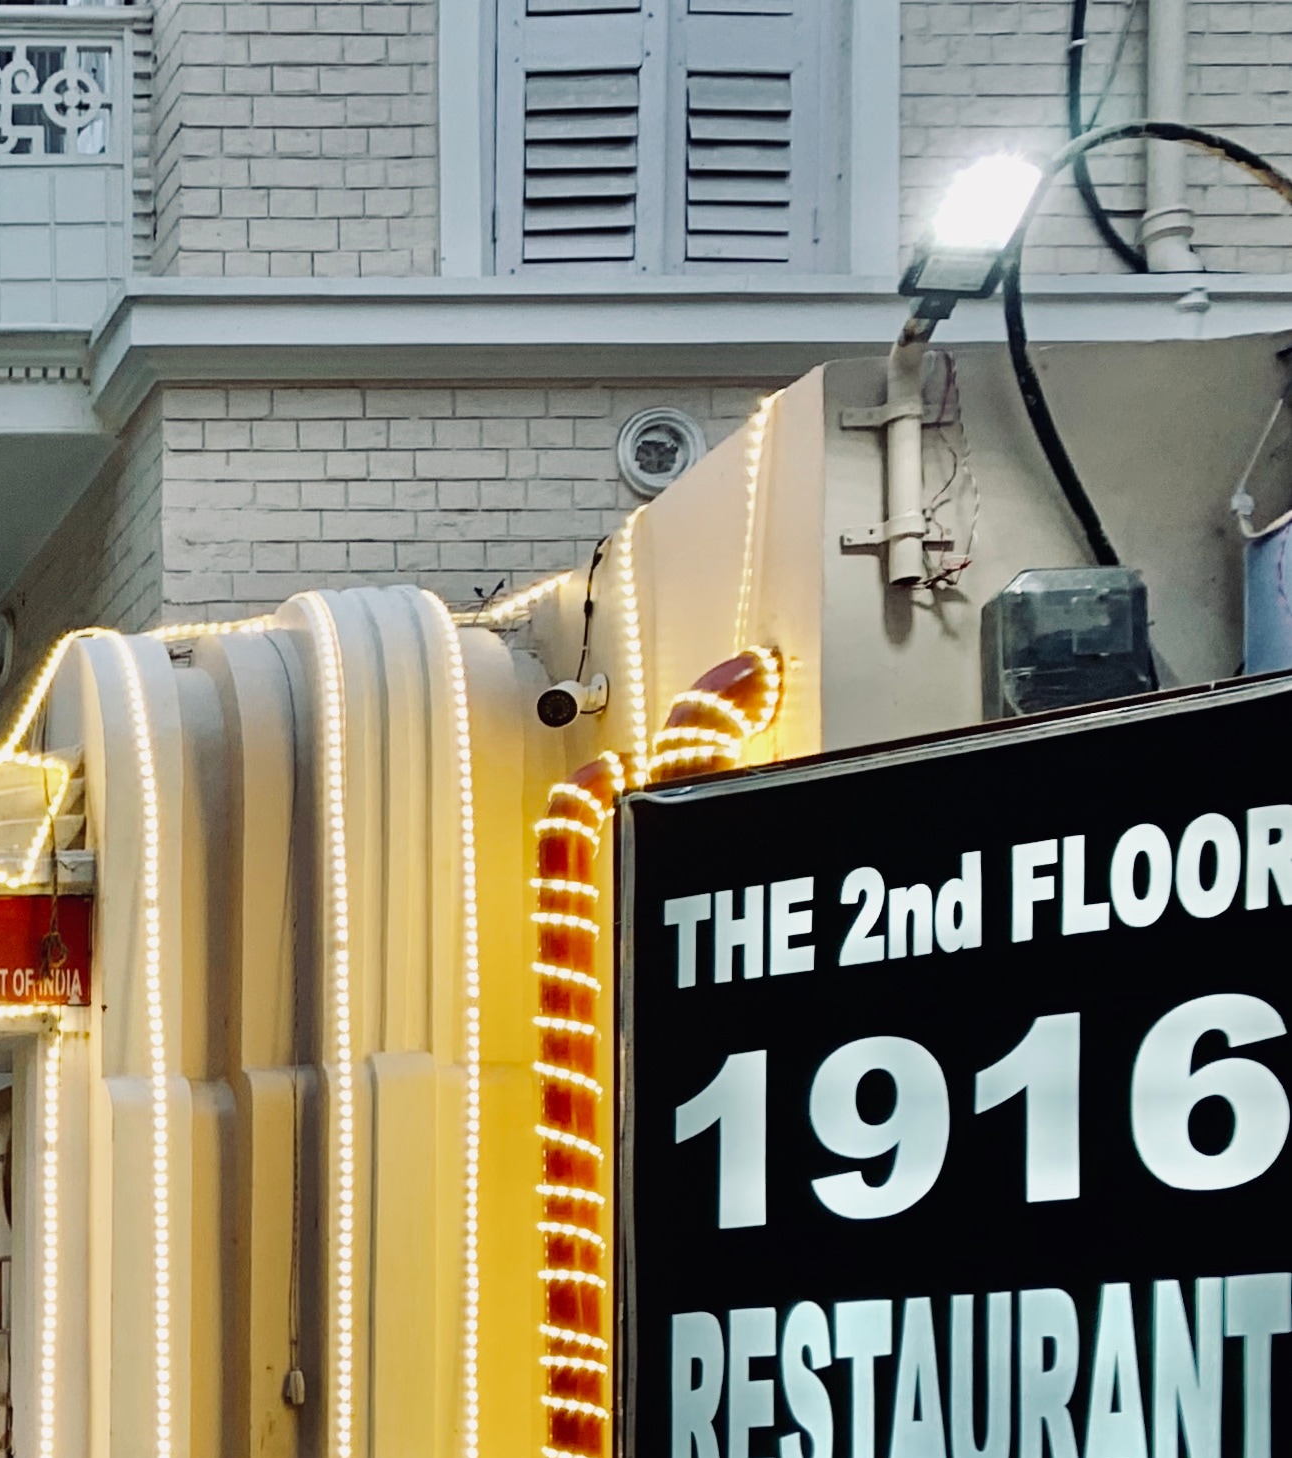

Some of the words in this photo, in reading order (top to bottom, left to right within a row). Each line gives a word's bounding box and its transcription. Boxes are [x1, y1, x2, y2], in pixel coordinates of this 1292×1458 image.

[14, 970, 33, 996] OF
[665, 877, 815, 988] THE
[839, 851, 981, 966] 2nd
[1012, 805, 1292, 942] FLOOR
[676, 993, 1290, 1229] 1916
